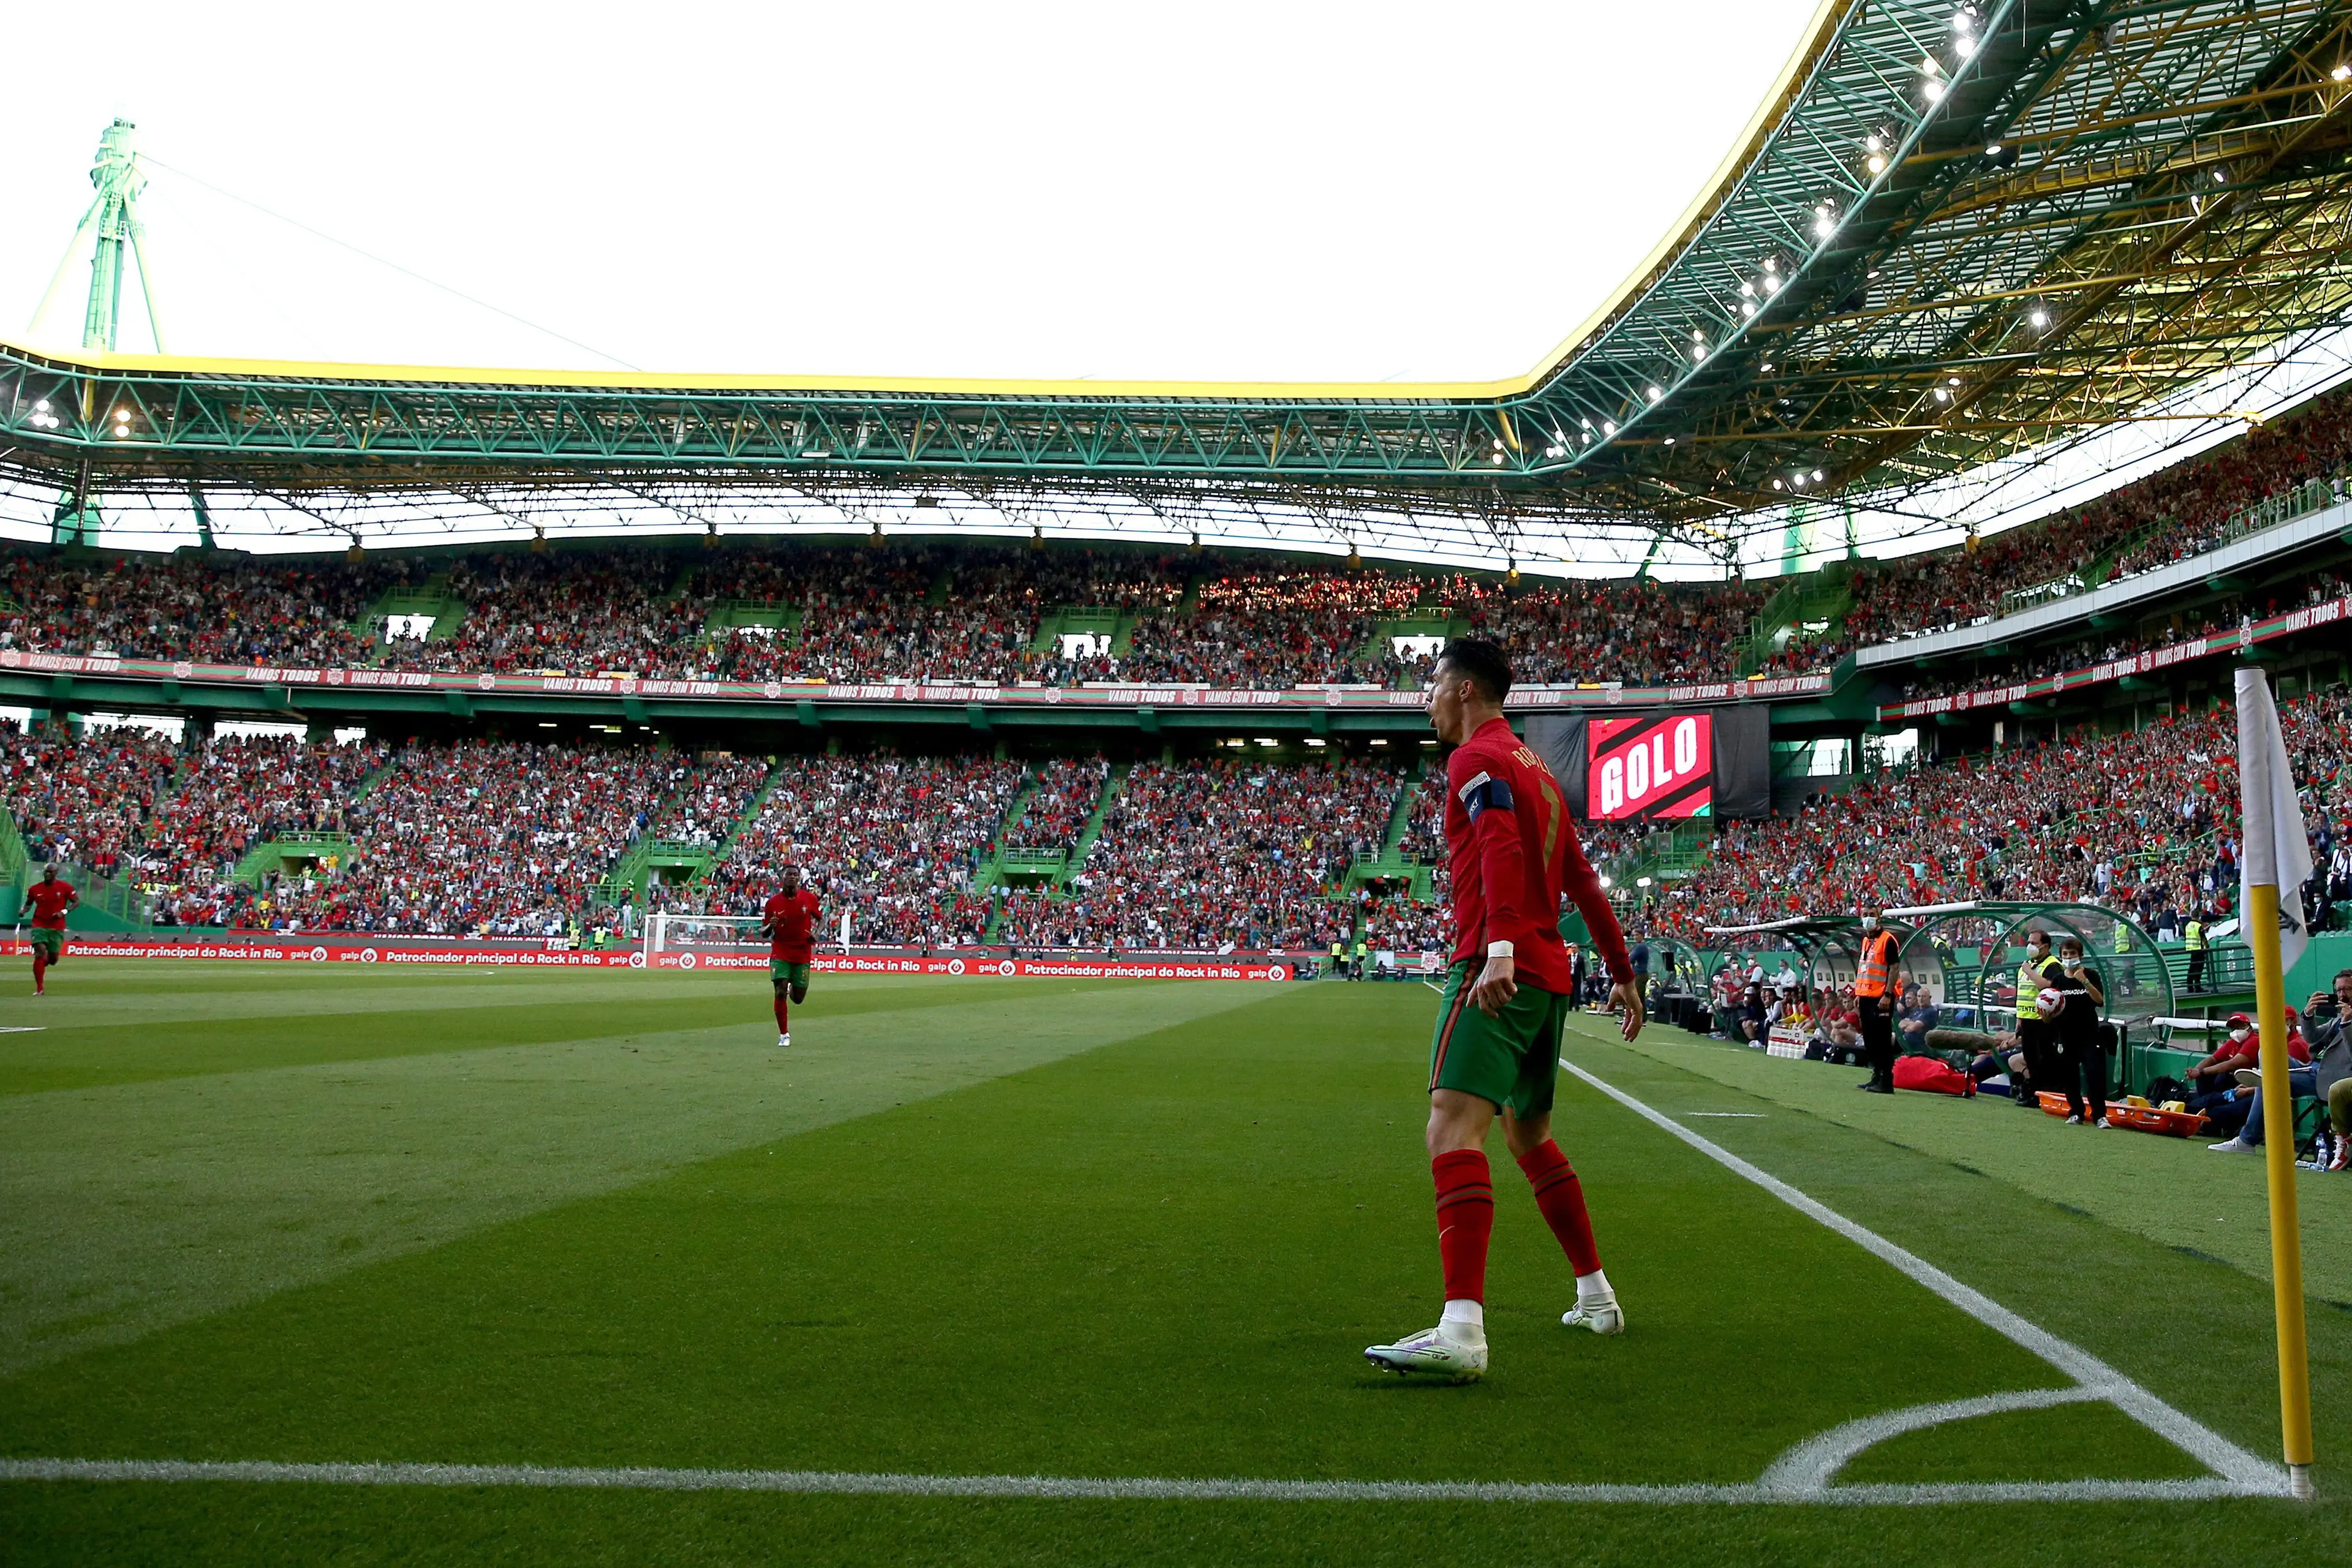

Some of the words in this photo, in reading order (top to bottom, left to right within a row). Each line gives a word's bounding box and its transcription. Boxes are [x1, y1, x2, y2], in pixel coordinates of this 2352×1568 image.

[2285, 611, 2310, 632] VAMOS
[2311, 601, 2339, 625] TODOS
[2155, 647, 2173, 666] VAMOS
[2174, 644, 2185, 663] COM
[2187, 639, 2207, 658] TUDO
[29, 655, 61, 669] VAMOS
[62, 657, 83, 670] COM
[85, 658, 120, 672] TUDO
[2093, 664, 2113, 682] VAMOS
[2113, 658, 2136, 677] TODOS
[246, 668, 281, 680] VAMOS
[281, 669, 320, 682] TODOS
[351, 671, 379, 683] VAMOS
[381, 672, 399, 684] COM
[400, 673, 431, 685] TUDO
[543, 677, 574, 690] VAMOS
[575, 679, 612, 691] TODOS
[643, 680, 669, 693] VAMOS
[670, 681, 688, 693] COM
[689, 682, 719, 694] TUDO
[1754, 680, 1776, 693] VAMOS
[1779, 679, 1794, 692] COM
[1796, 676, 1823, 690] TUDO
[828, 685, 858, 698] VAMOS
[859, 686, 896, 698] TODOS
[925, 687, 951, 699] VAMOS
[952, 687, 970, 699] COM
[971, 688, 1001, 700] TUDO
[1108, 690, 1138, 702] VAMOS
[1137, 690, 1176, 703] TODOS
[1205, 690, 1232, 703] VAMOS
[1232, 691, 1250, 703] COM
[1251, 692, 1280, 704] TUDO
[1389, 692, 1419, 704] VAMOS
[1514, 692, 1531, 703] COM
[1532, 692, 1561, 703] TUDO
[1669, 687, 1695, 700] VAMOS
[1697, 685, 1727, 698] TODOS
[1973, 691, 1993, 706] VAMOS
[1994, 688, 2007, 703] COM
[2008, 685, 2027, 701] TUDO
[1904, 701, 1924, 717] VAMOS
[1926, 697, 1952, 713] TODOS
[1601, 717, 1697, 815] GOLO
[1540, 777, 1560, 874] 7
[67, 945, 146, 956] Patrocinador
[147, 946, 199, 959] principal
[202, 947, 216, 957] do
[219, 948, 247, 958] Rock
[250, 948, 262, 958] in
[263, 948, 282, 959] Rio
[290, 951, 309, 959] galp
[341, 952, 359, 960] galp
[386, 951, 463, 963] Patrocinador
[466, 952, 518, 965] principal
[520, 954, 535, 963] do
[537, 953, 565, 964] Rock
[568, 953, 579, 964] in
[582, 954, 601, 965] Rio
[609, 956, 628, 966] galp
[659, 957, 677, 967] galp
[705, 956, 770, 967] Patrocinad
[838, 959, 854, 970] do
[857, 959, 885, 970] Rock
[888, 959, 898, 971] in
[900, 960, 920, 971] Rio
[928, 962, 946, 973] galp
[978, 963, 997, 973] galp
[1025, 963, 1102, 976] Patrocinador
[1105, 965, 1156, 978] principal
[1158, 966, 1174, 977] do
[1176, 966, 1205, 978] Rock
[1207, 967, 1218, 978] in
[1221, 967, 1240, 978] Rio
[1248, 969, 1267, 979] galp
